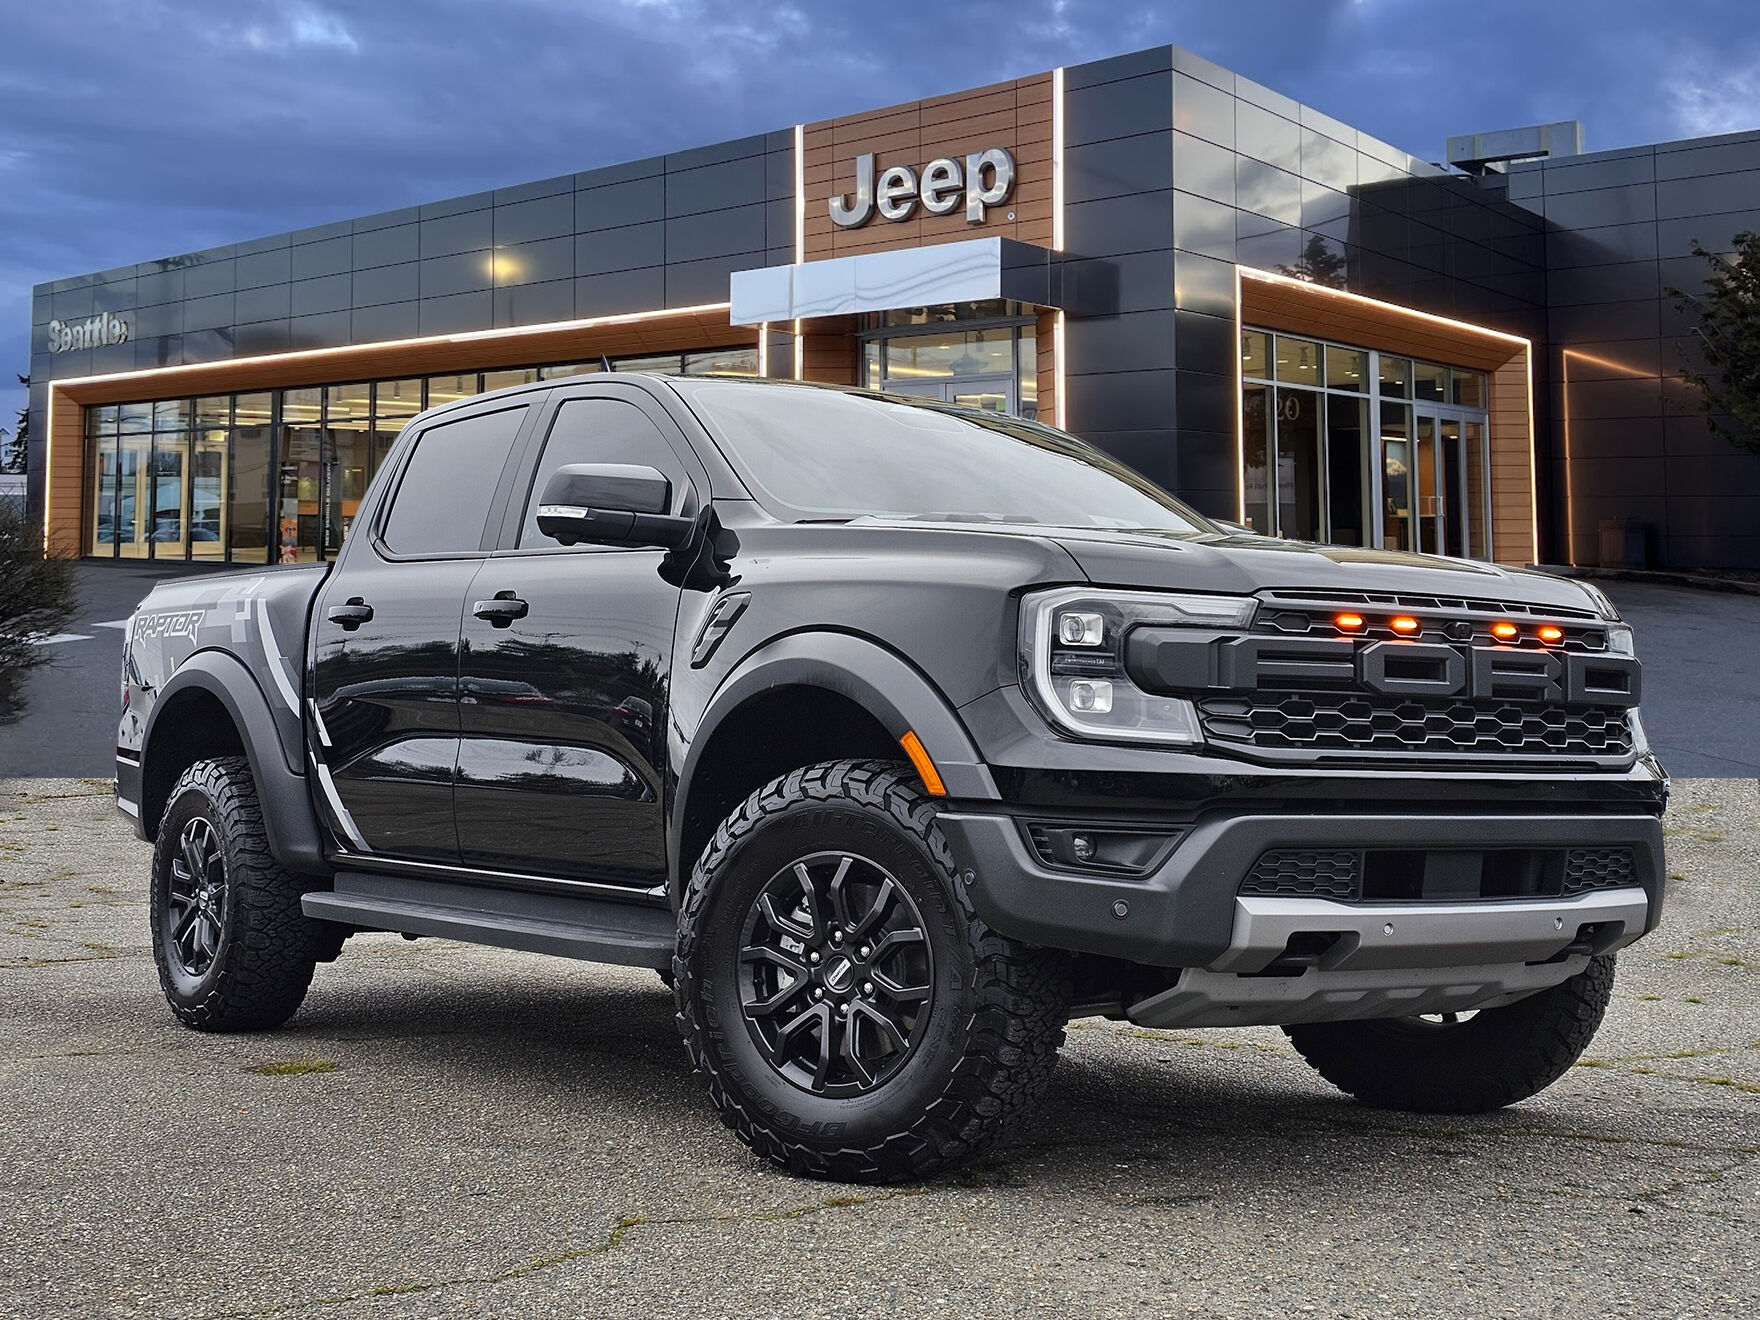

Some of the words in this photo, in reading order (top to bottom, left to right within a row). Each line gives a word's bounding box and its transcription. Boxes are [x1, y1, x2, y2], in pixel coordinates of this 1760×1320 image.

[829, 147, 1016, 229] Jeep
[48, 312, 128, 353] Seattle
[134, 609, 206, 649] RAPTOR
[1216, 636, 1642, 706] FORD
[790, 811, 947, 914] All-Terrain
